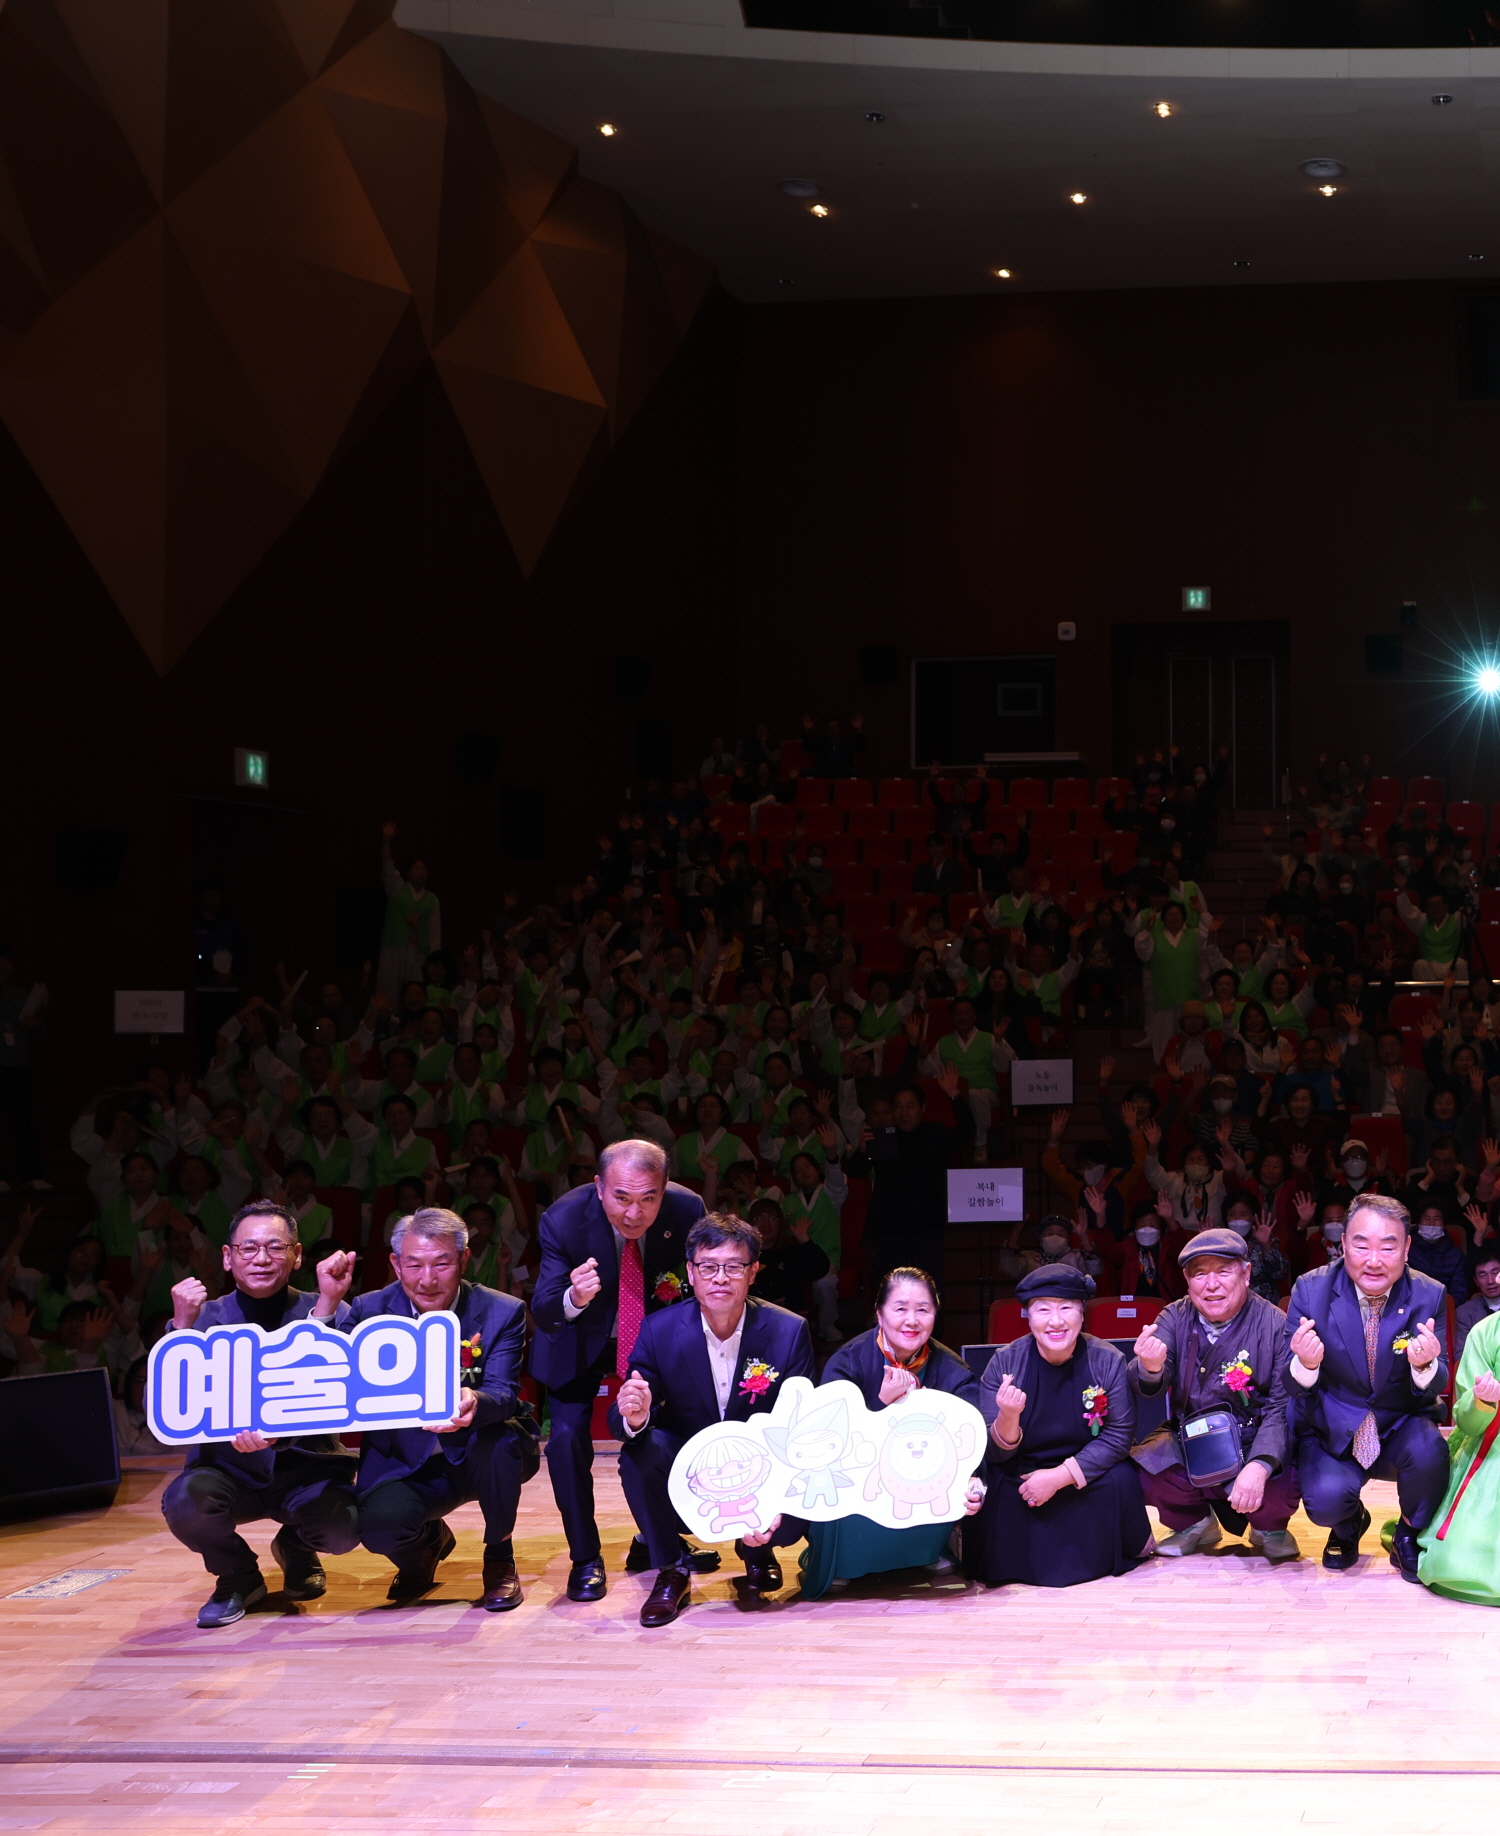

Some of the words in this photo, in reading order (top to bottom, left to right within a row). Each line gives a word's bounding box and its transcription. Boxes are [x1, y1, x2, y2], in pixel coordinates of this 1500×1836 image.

[1035, 1071, 1050, 1080] 노동
[976, 1181, 995, 1192] 복내
[967, 1196, 1004, 1208] 길쌈놀이
[159, 1320, 449, 1432] 예술의
